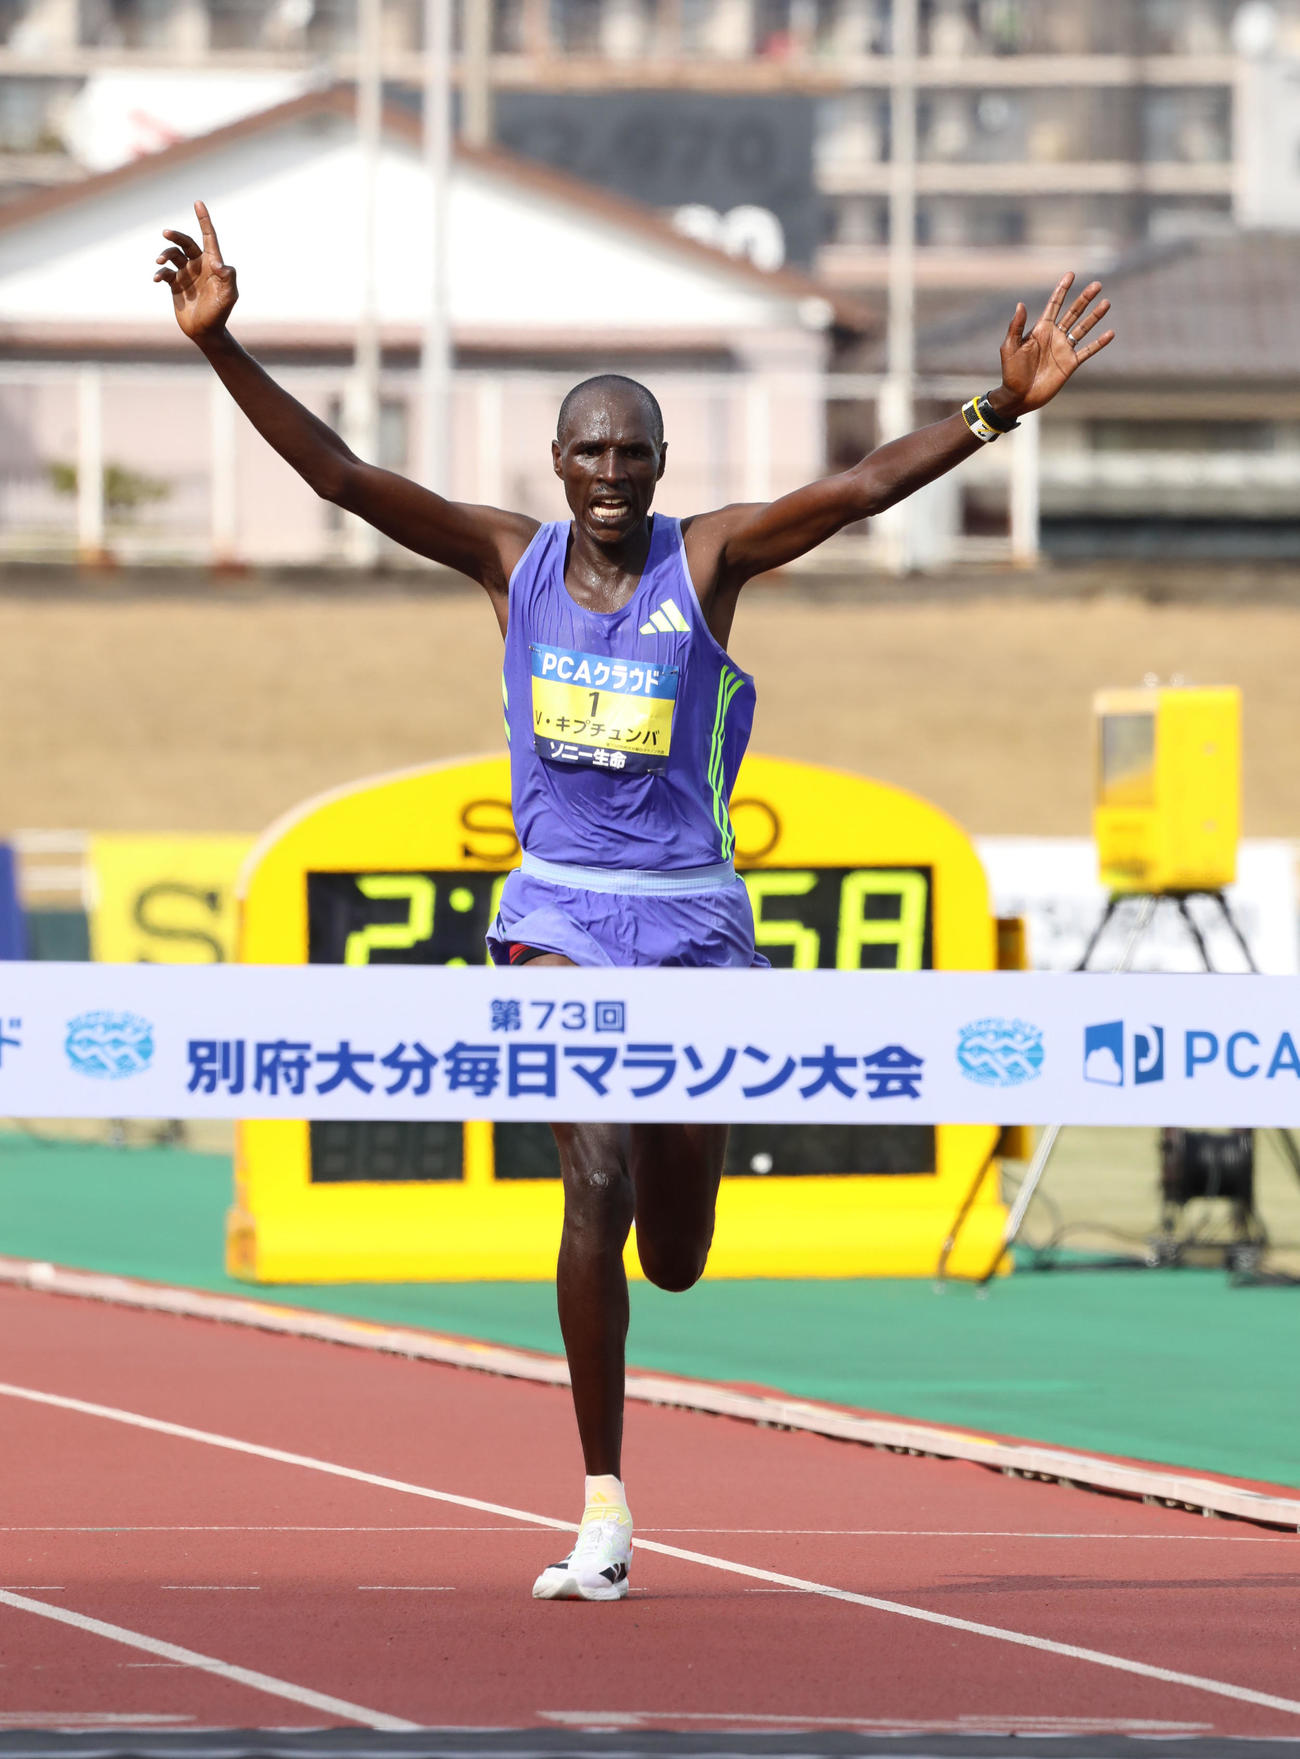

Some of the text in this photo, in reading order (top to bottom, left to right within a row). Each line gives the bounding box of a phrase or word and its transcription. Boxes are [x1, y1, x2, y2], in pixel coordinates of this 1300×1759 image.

[541, 652, 660, 693] PCAクラウド
[588, 691, 600, 717] 1
[550, 741, 627, 769] ソニー生命
[491, 999, 625, 1033] 第73回
[187, 1040, 924, 1098] 別府大分毎日マラソン大会
[1185, 1030, 1300, 1079] PCA
